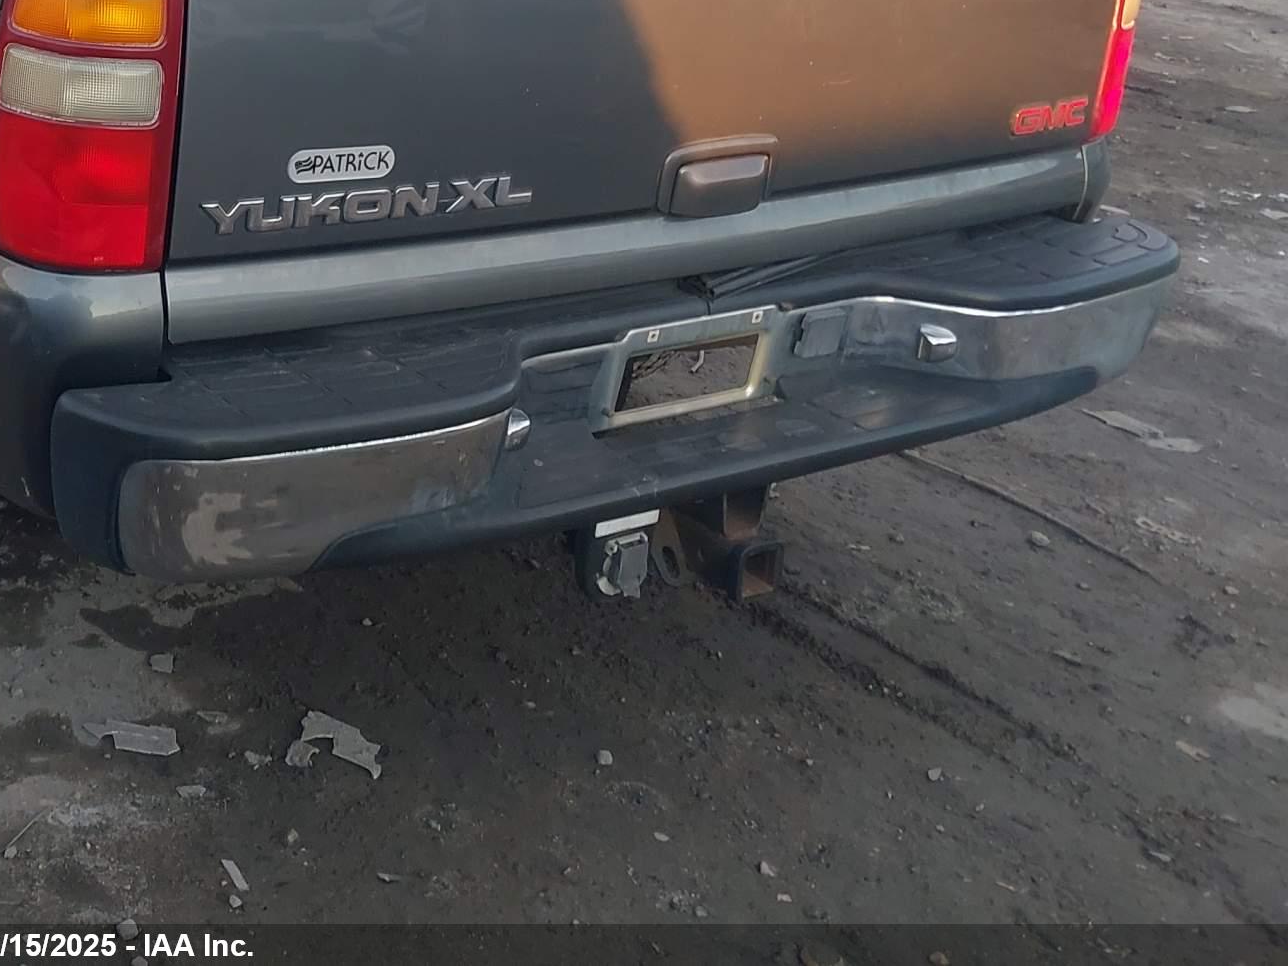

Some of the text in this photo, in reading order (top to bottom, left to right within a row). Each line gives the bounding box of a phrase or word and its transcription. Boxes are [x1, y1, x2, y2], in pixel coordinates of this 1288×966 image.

[1013, 98, 1088, 134] GMC
[200, 176, 533, 234] YUKON XL
